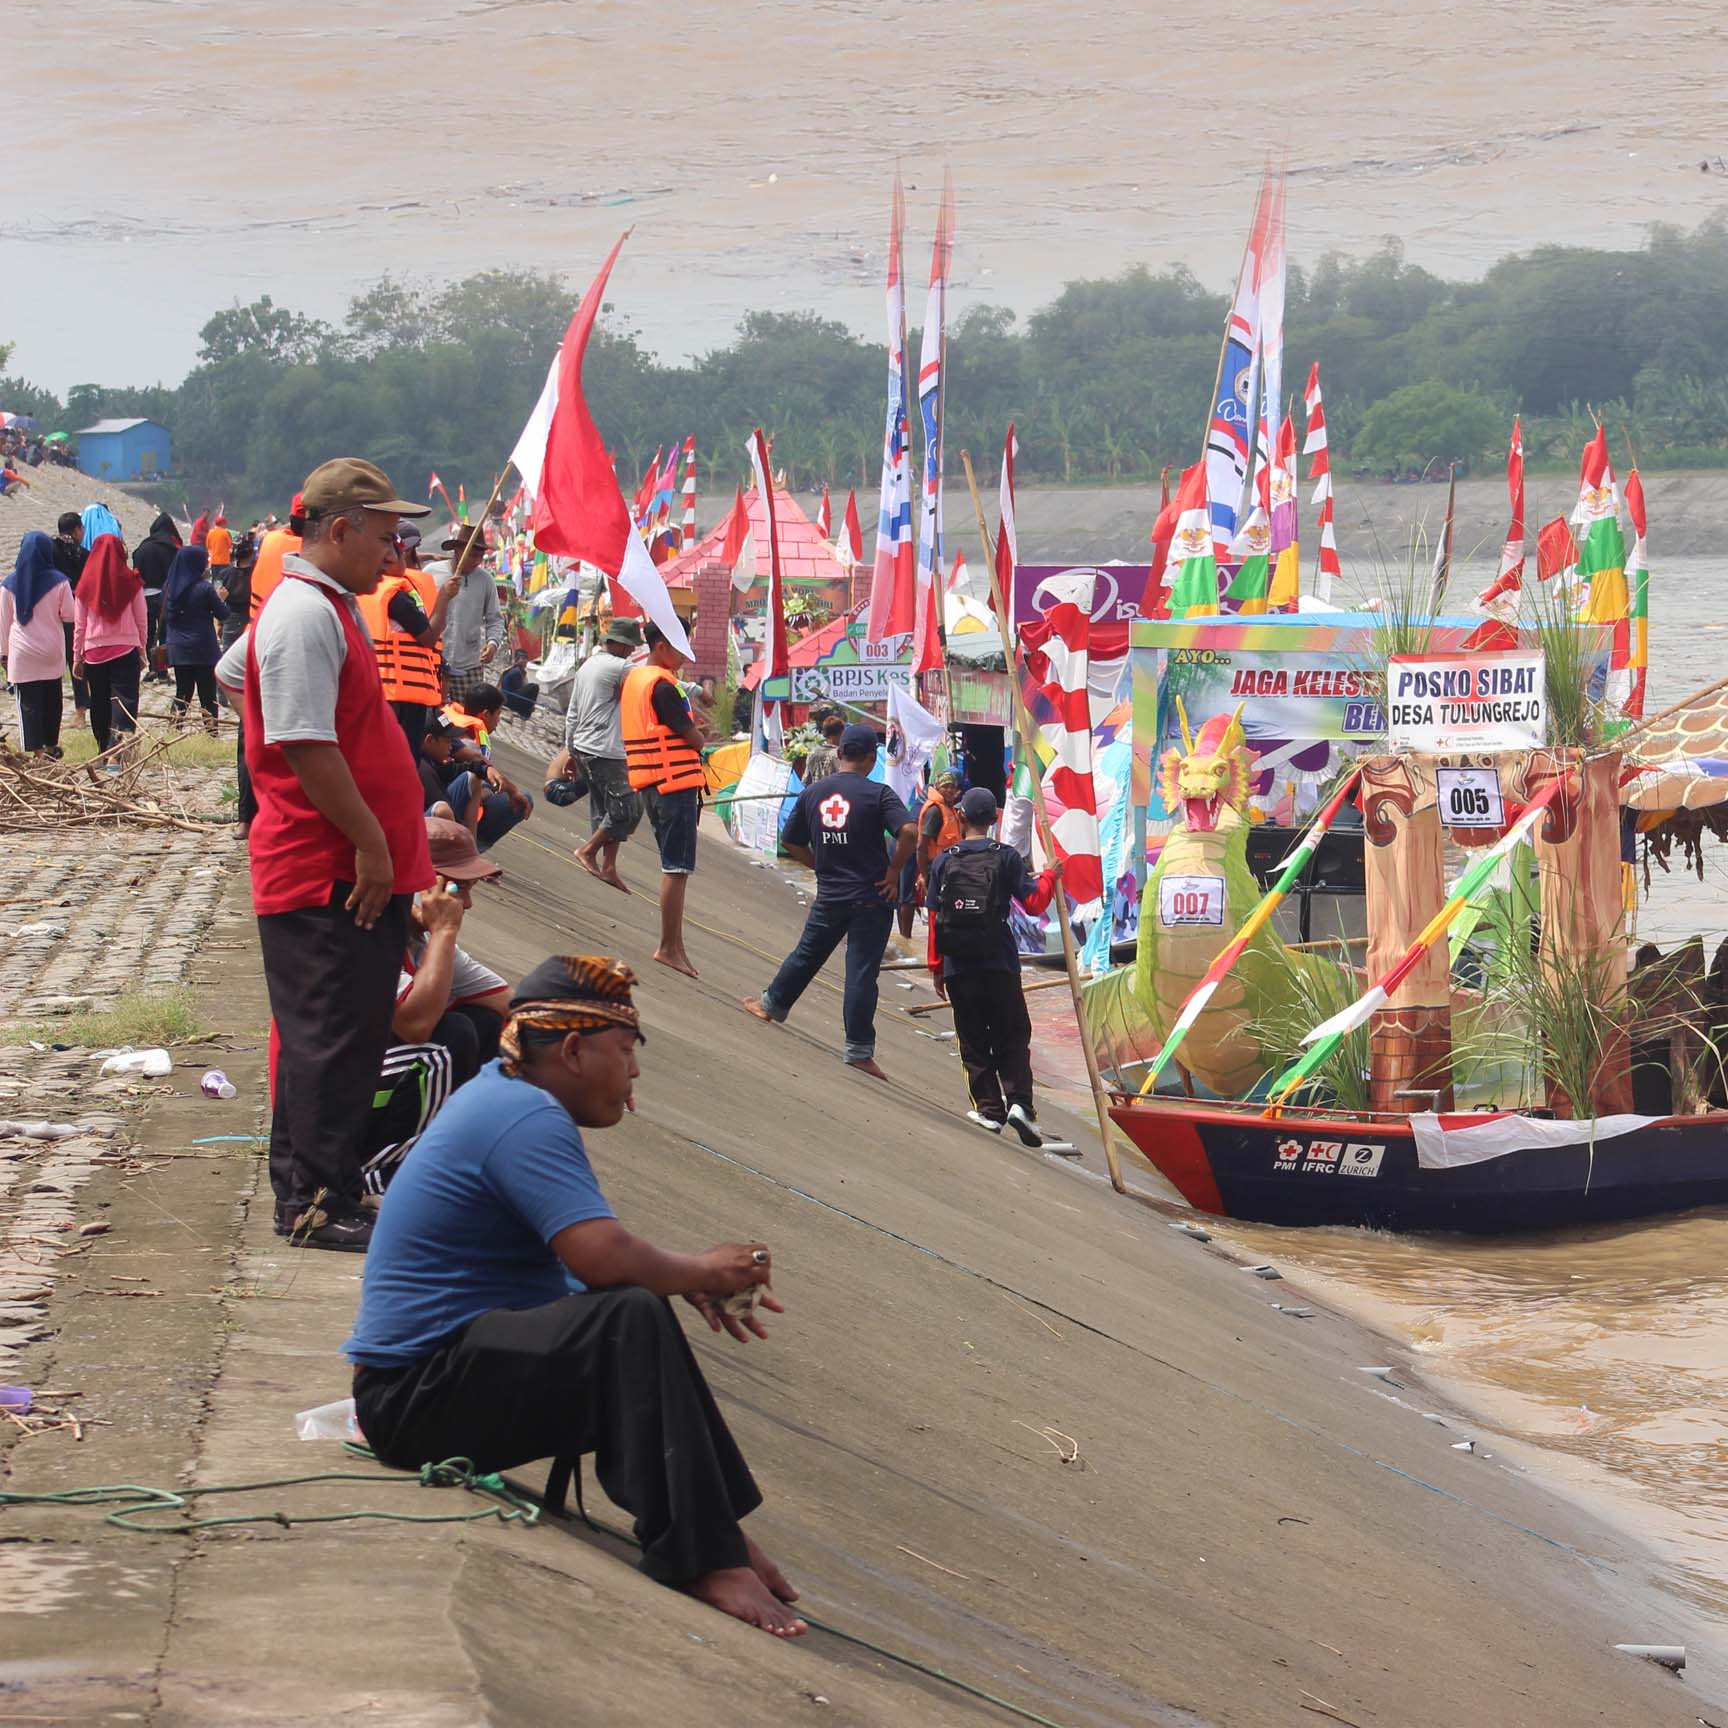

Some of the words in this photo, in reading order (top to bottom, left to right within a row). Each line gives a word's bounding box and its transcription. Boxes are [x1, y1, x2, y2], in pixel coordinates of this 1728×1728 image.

[865, 643, 889, 657] 003
[832, 669, 874, 687] BPJS
[1231, 669, 1288, 697] JAGA
[1397, 669, 1471, 698] POSKO
[1477, 667, 1537, 696] SIBAT
[832, 689, 858, 698] Badan
[1392, 704, 1434, 725] DESA
[1440, 700, 1540, 725] TULUNGREJO
[1449, 787, 1490, 816] 005
[821, 830, 849, 846] PMI
[1173, 891, 1210, 917] 007
[1273, 1161, 1297, 1171] PMI
[1301, 1161, 1336, 1174] IFRC
[1340, 1164, 1376, 1176] ZURICH
